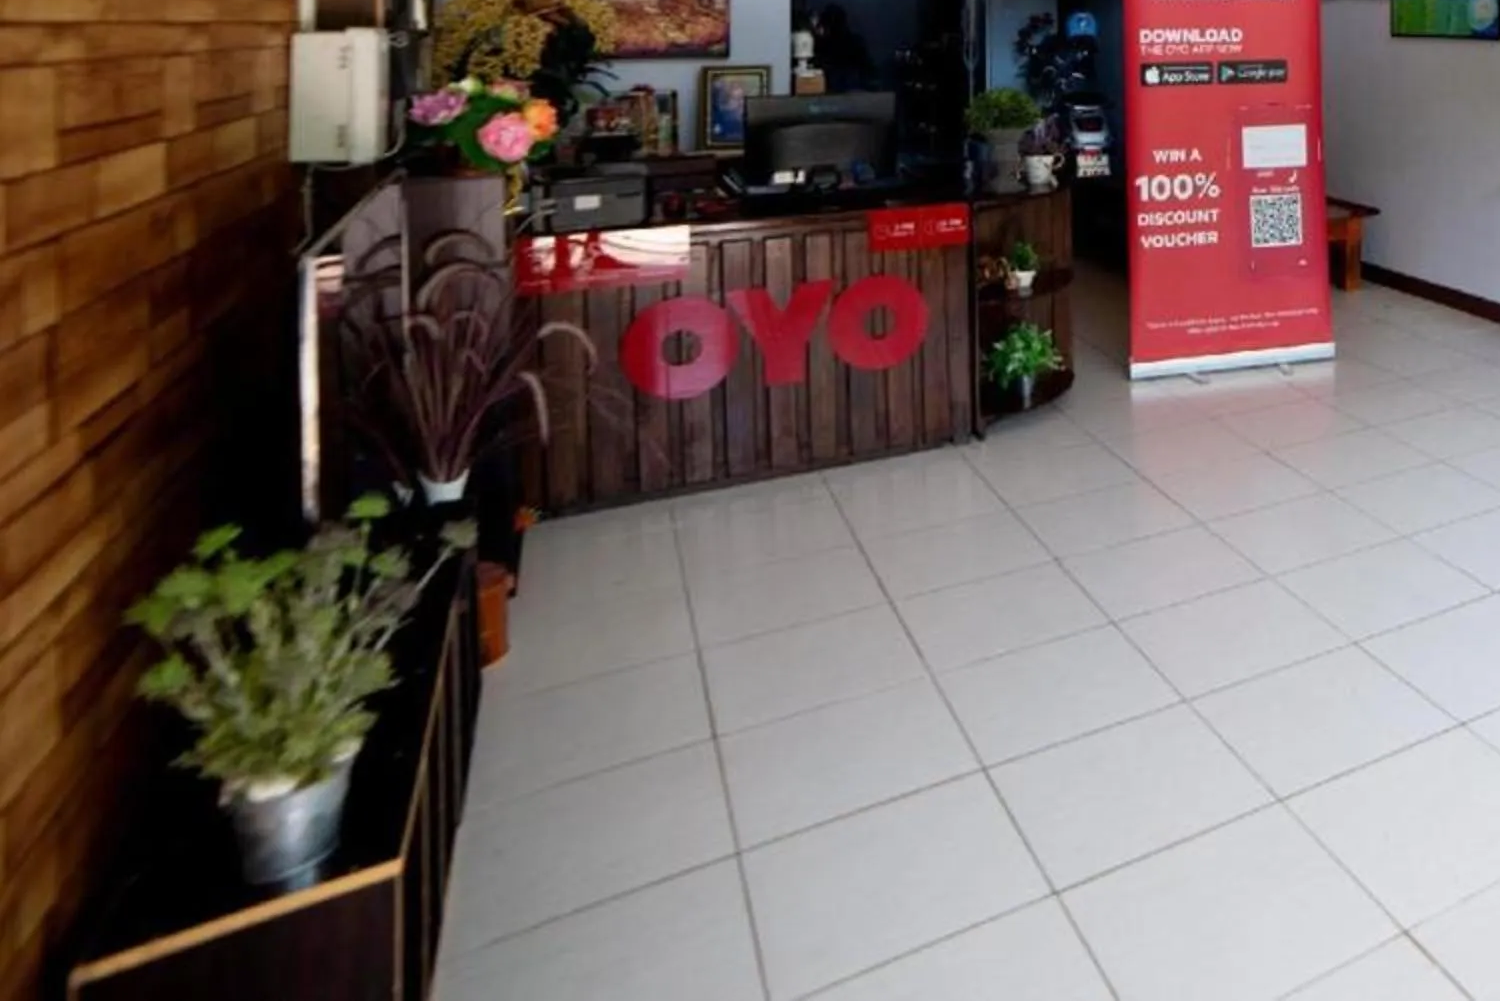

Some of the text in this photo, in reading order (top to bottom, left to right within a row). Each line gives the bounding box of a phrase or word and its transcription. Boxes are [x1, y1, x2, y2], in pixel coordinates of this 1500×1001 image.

[1139, 28, 1243, 44] DOWNLOAD
[1162, 70, 1209, 84] App Store
[1153, 148, 1203, 163] WIN A
[1135, 172, 1221, 202] 100%
[1137, 209, 1219, 227] DISCOUNT
[1140, 231, 1219, 248] VOUCHER
[618, 273, 929, 401] OYO
